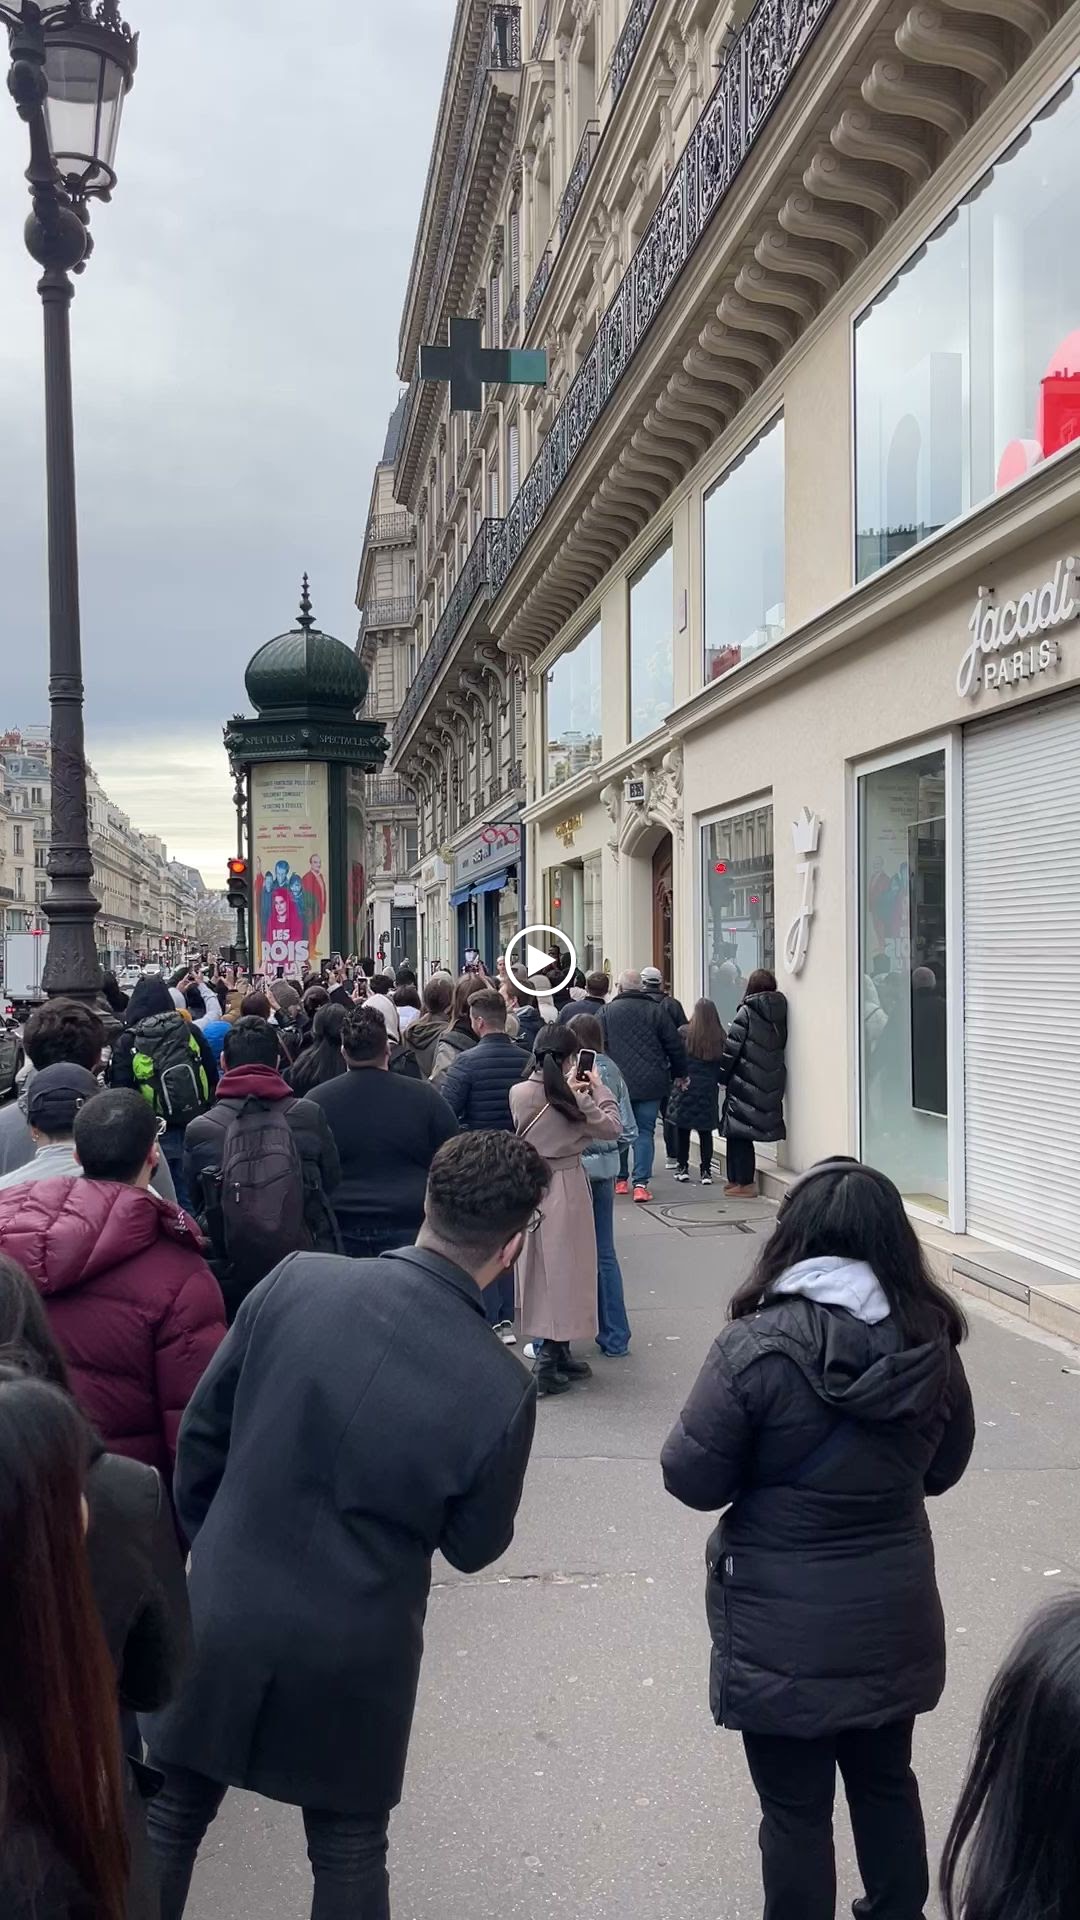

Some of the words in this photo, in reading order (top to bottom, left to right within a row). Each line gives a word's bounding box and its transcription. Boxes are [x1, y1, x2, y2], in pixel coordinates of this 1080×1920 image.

[956, 556, 1078, 698] jacadi
[984, 639, 1055, 690] PARIS
[245, 734, 296, 745] SPECTACLES
[319, 734, 370, 747] SPECTACLES
[272, 928, 291, 941] LES
[261, 940, 310, 962] ROIS
